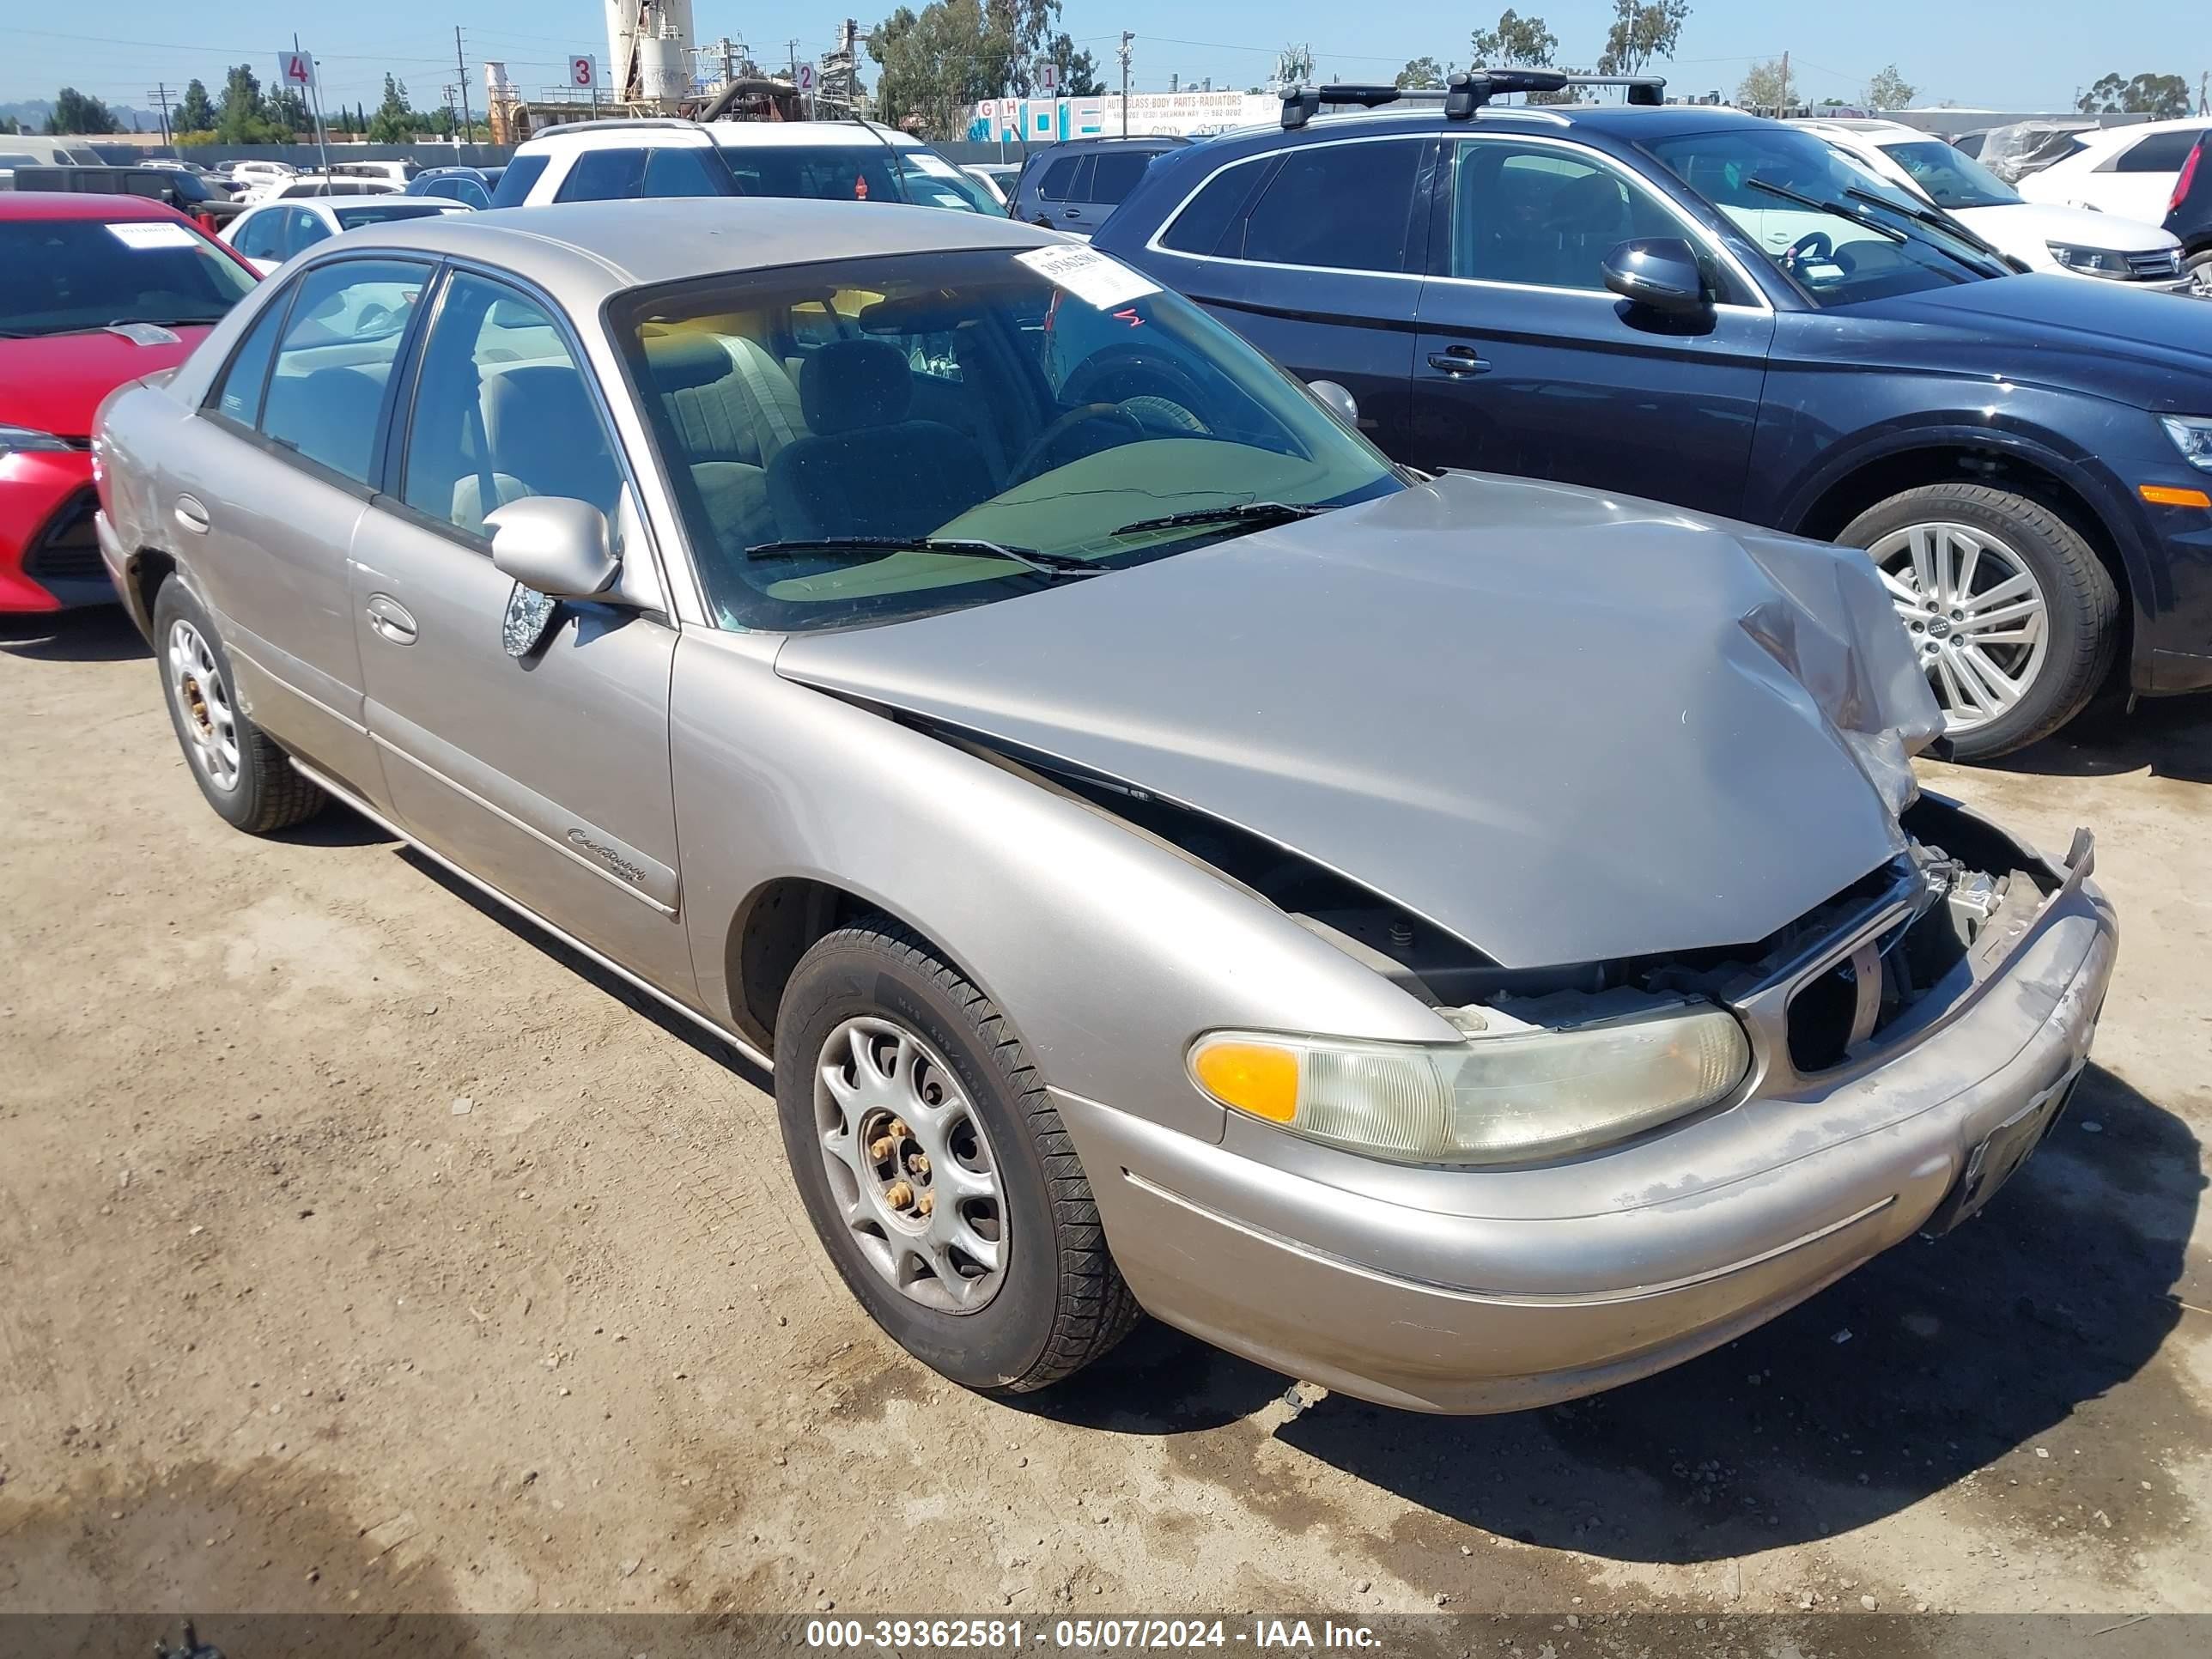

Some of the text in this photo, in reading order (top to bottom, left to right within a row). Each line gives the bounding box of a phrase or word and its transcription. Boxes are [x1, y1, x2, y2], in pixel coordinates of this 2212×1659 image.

[289, 55, 308, 82] 4
[575, 59, 591, 84] 3
[800, 65, 812, 88] 2
[1044, 68, 1054, 88] 1
[981, 101, 992, 117] G
[1006, 100, 1017, 114] H
